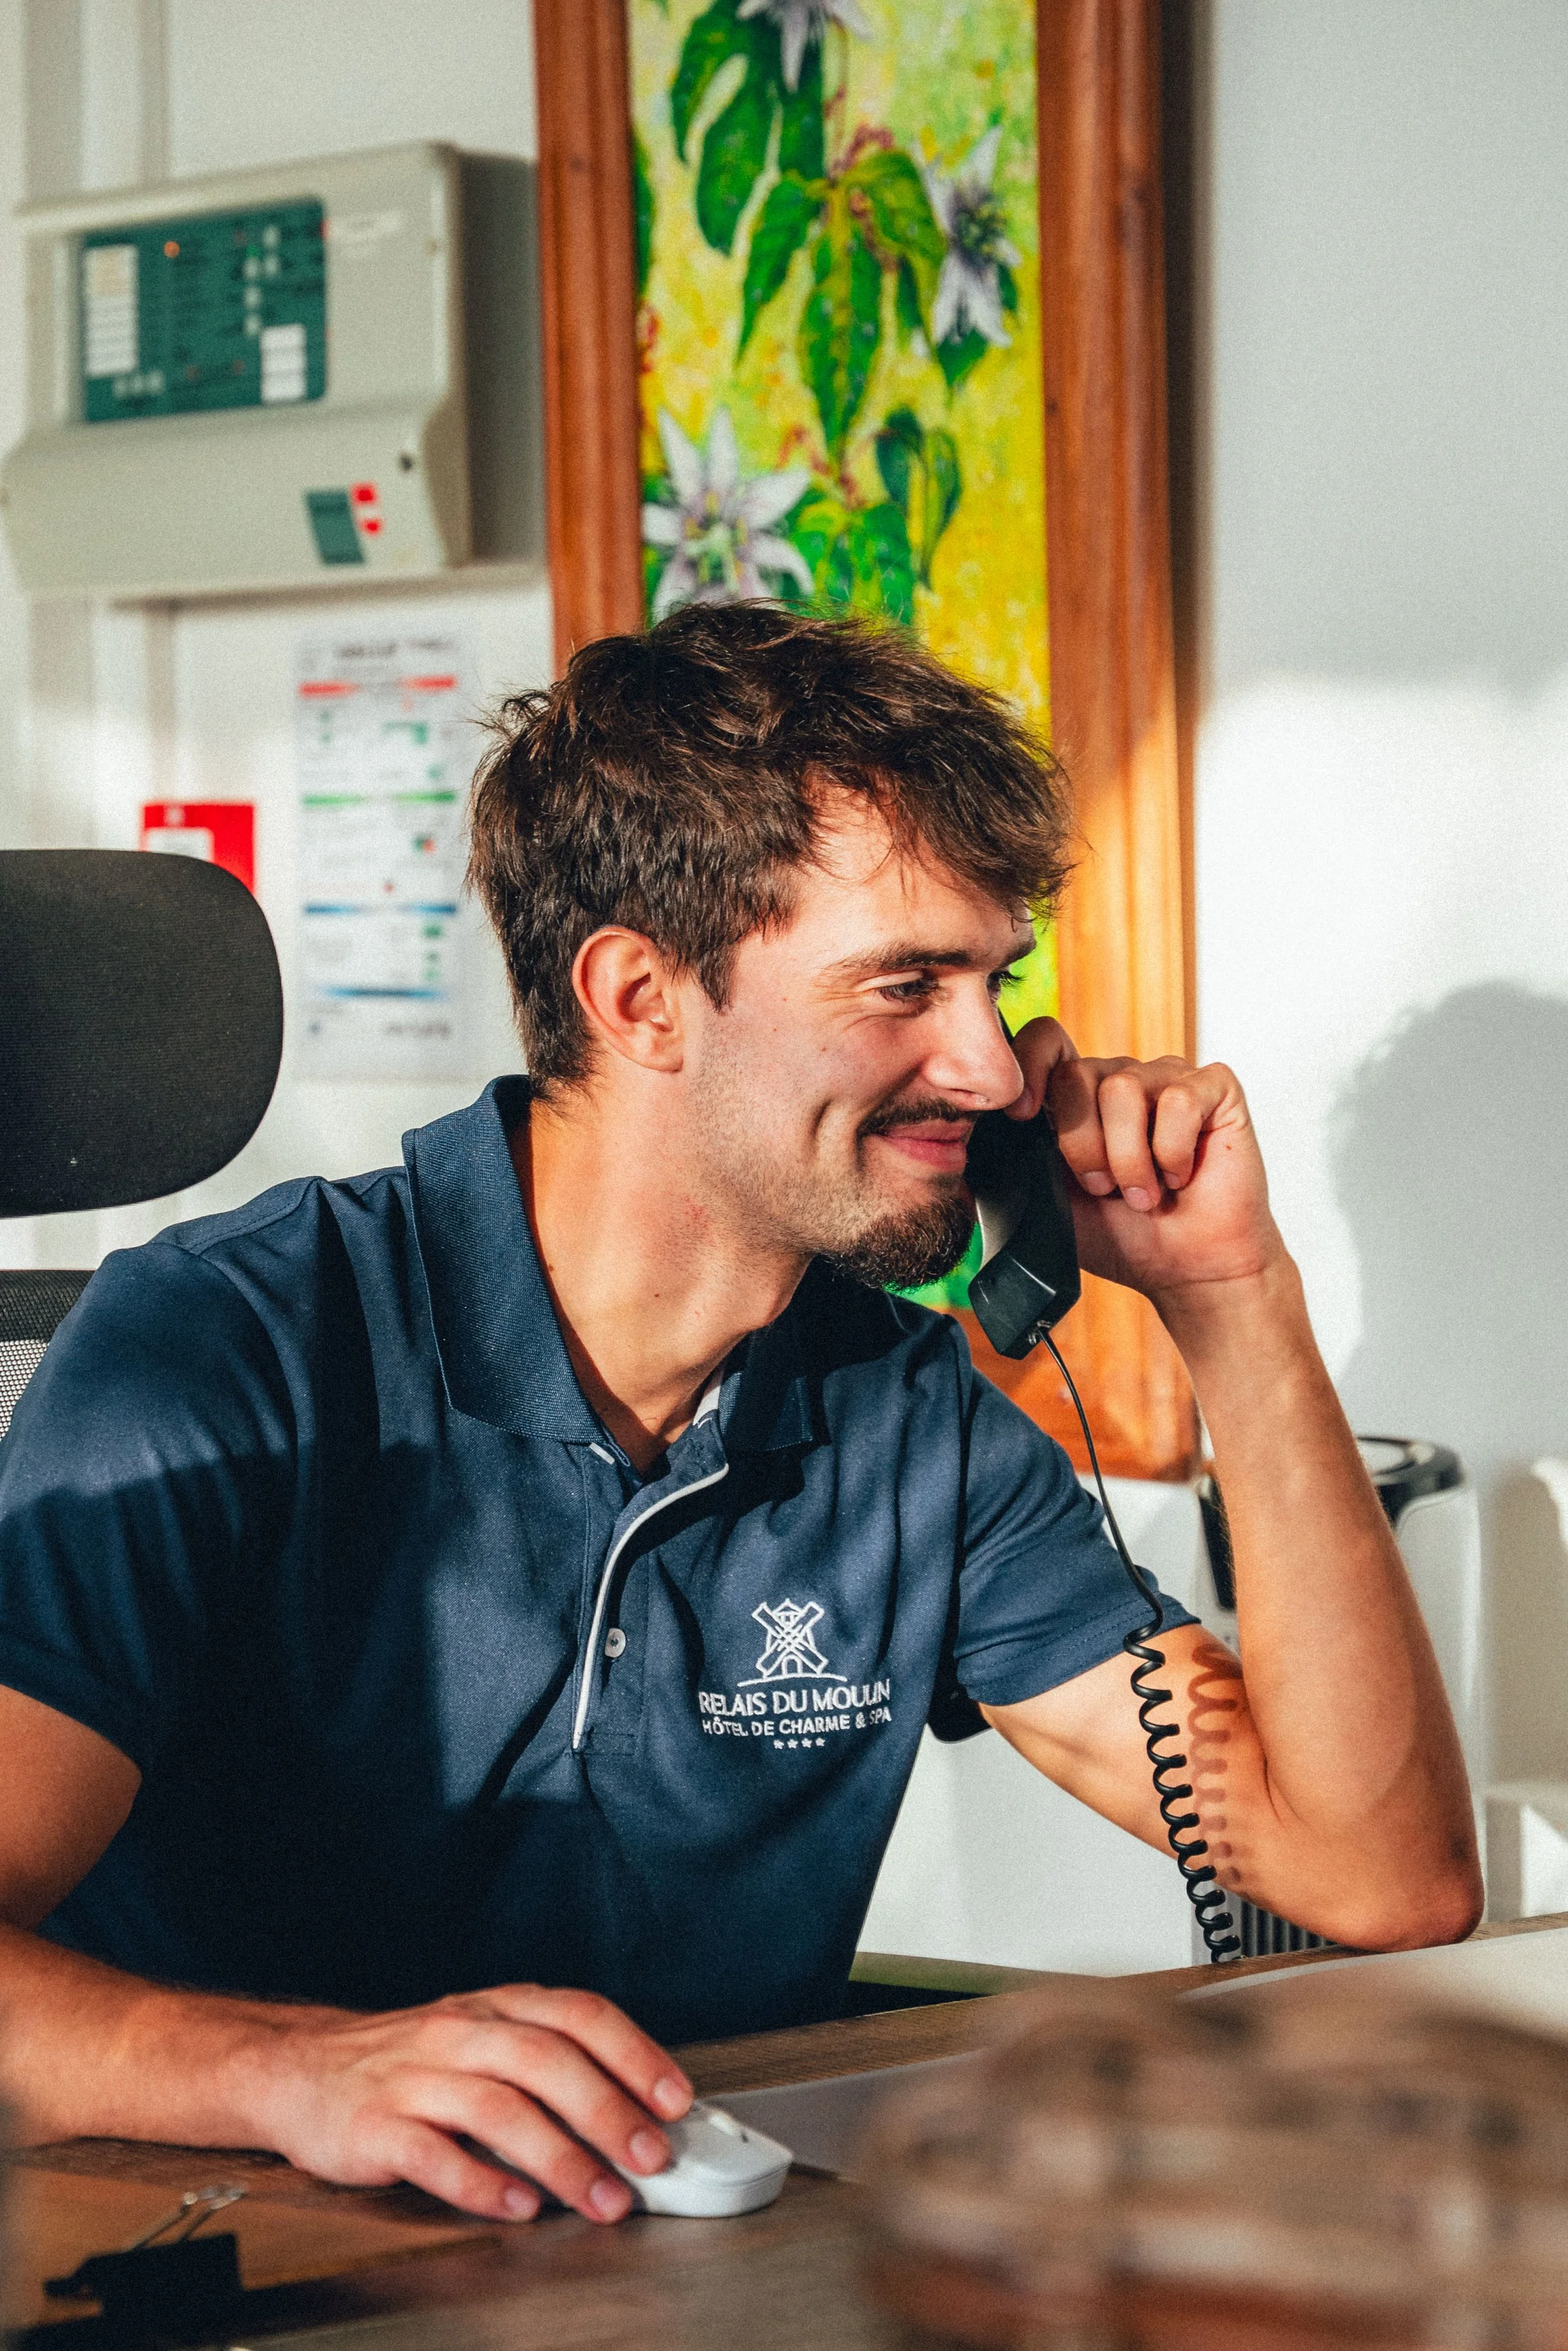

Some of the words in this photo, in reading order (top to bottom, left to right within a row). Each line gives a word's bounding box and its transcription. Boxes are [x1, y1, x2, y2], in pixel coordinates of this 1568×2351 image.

[698, 1691, 767, 1716] RELAIS
[772, 1689, 808, 1714] DU
[812, 1679, 891, 1712] MOULIN
[702, 1717, 748, 1736] HÔTEL
[751, 1721, 775, 1736] DE
[779, 1715, 850, 1734] CHARME
[855, 1712, 866, 1729] &
[869, 1707, 892, 1725] SPA
